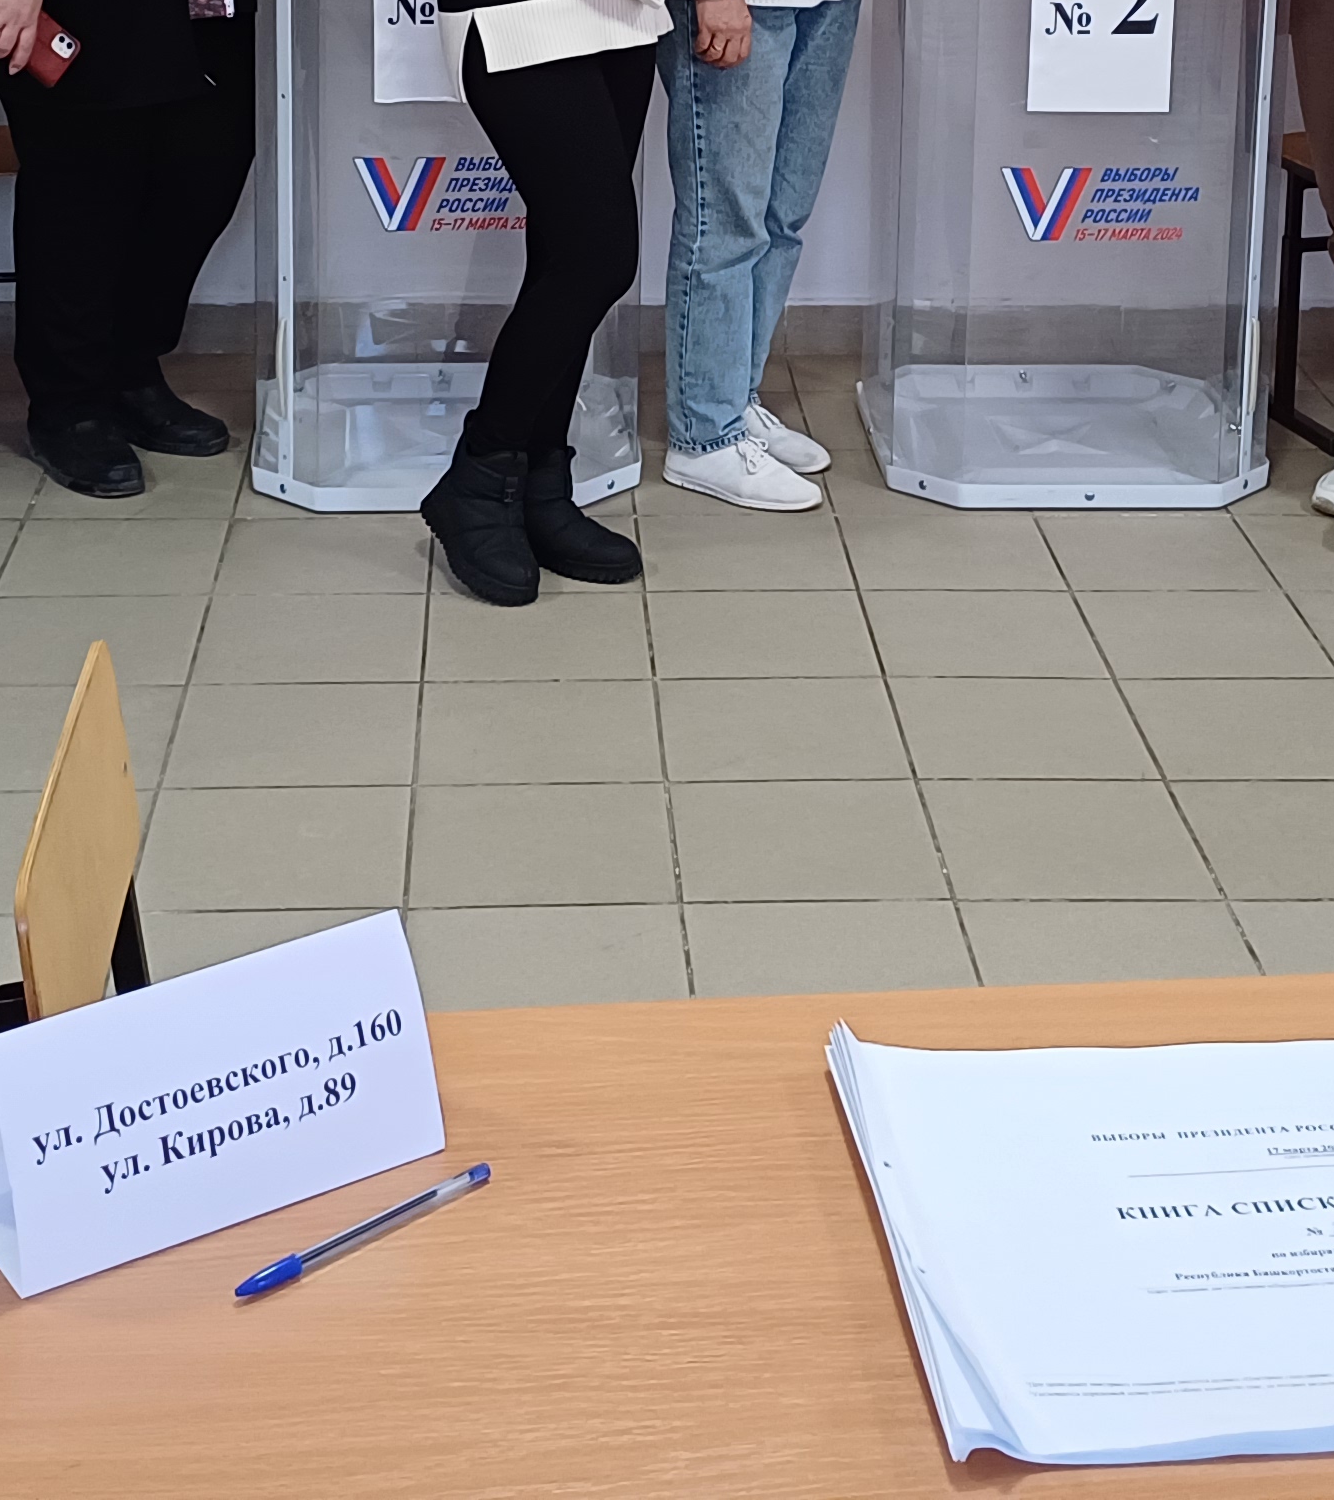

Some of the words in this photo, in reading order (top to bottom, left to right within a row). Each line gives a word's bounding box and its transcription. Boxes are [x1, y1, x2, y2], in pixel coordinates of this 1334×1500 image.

[1045, 2, 1092, 35] №
[1100, 167, 1180, 183] ВЫБОРЫ
[1091, 187, 1200, 205] ПРЕЗИДЕНТА
[436, 198, 509, 213] РОССИИ
[466, 217, 509, 231] МАРТА
[1081, 208, 1152, 224] РОССИИ
[1110, 228, 1152, 241] МАРТА
[1153, 227, 1183, 240] 2024
[31, 1125, 83, 1166] ул.
[93, 1046, 321, 1146] Достоевского,
[327, 1008, 403, 1061] д.160
[100, 1152, 151, 1195] ул.
[158, 1106, 291, 1167] Кирова,
[298, 1072, 357, 1122] д.89
[1091, 1132, 1166, 1142] ВЫБОРЫ
[1177, 1125, 1290, 1140] ПРЕЗИДЕНТА
[1116, 1203, 1223, 1220] КНИГА
[1175, 1271, 1250, 1282] Республика
